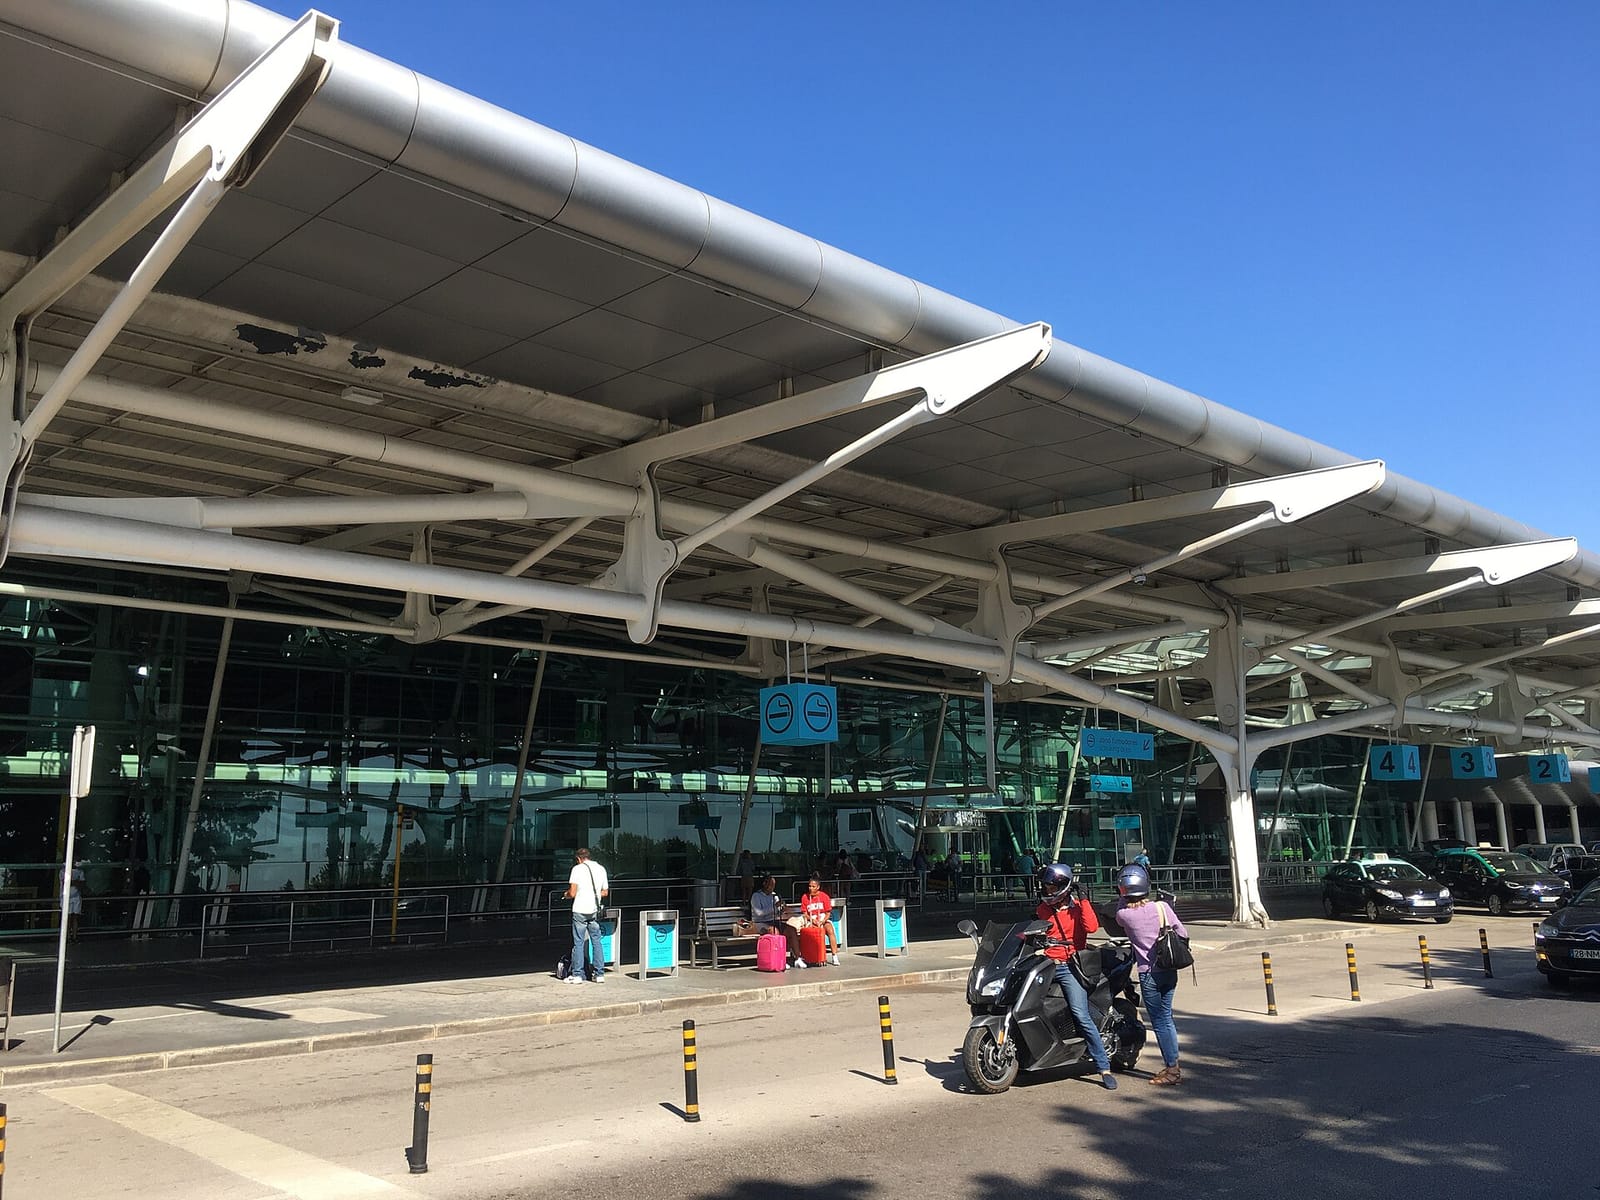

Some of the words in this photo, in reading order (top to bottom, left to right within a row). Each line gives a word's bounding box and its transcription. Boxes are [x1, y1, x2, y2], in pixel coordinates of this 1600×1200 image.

[1379, 750, 1396, 773] 4
[1407, 751, 1417, 773] 4
[1460, 751, 1475, 773] 3
[1485, 751, 1493, 772] 3
[1537, 759, 1553, 778] 2
[1560, 759, 1568, 777] 2
